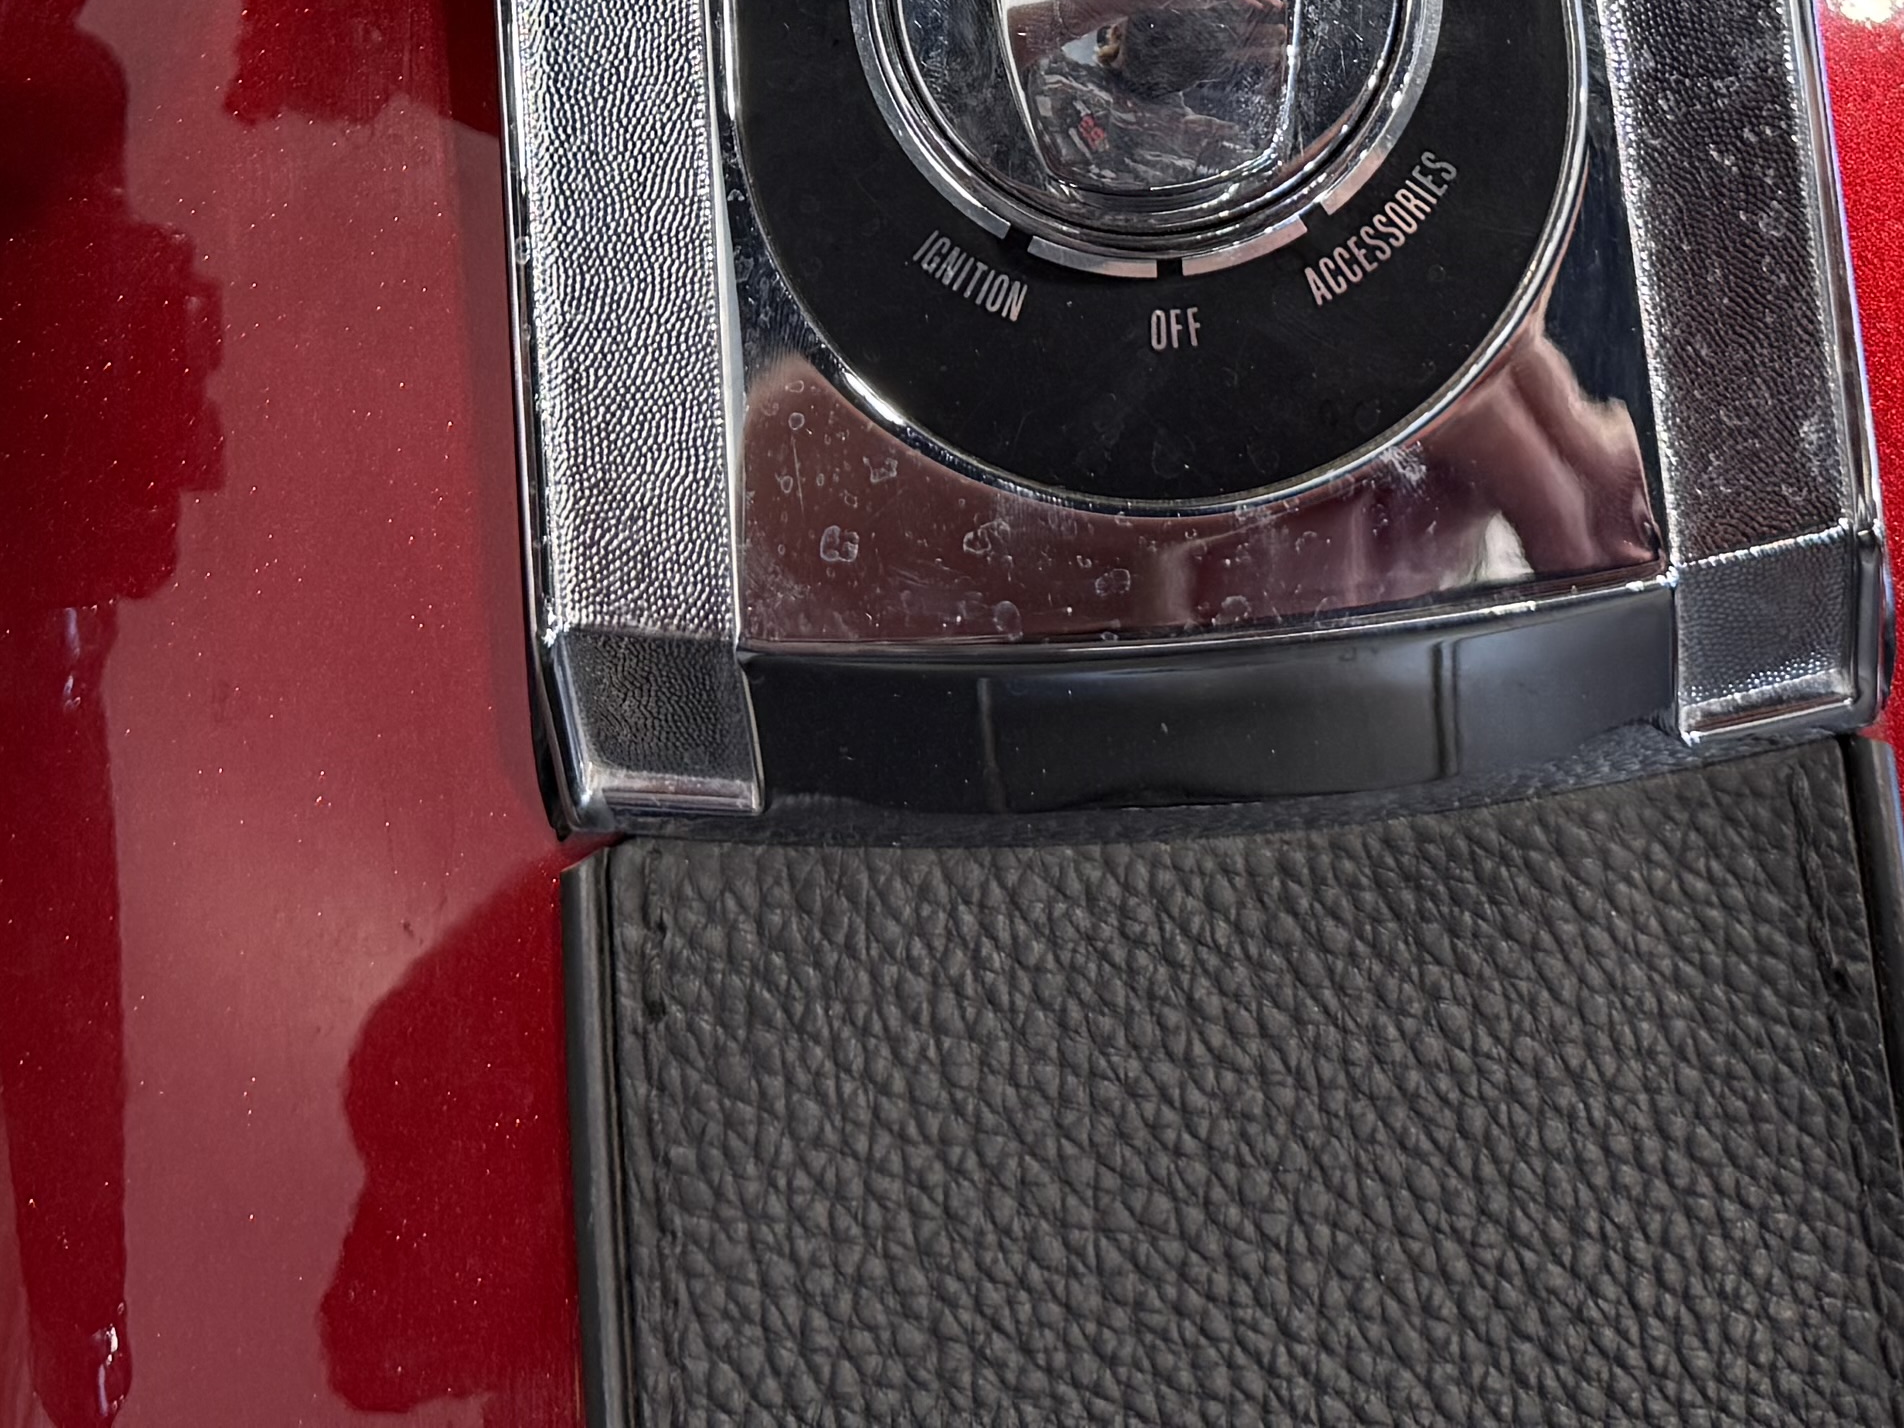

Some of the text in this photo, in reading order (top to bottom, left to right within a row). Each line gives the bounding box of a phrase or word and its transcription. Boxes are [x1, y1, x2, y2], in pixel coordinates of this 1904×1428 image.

[1302, 149, 1458, 307] ACCESSORIES
[910, 230, 1030, 322] IGNITION
[1149, 306, 1202, 352] OFF
